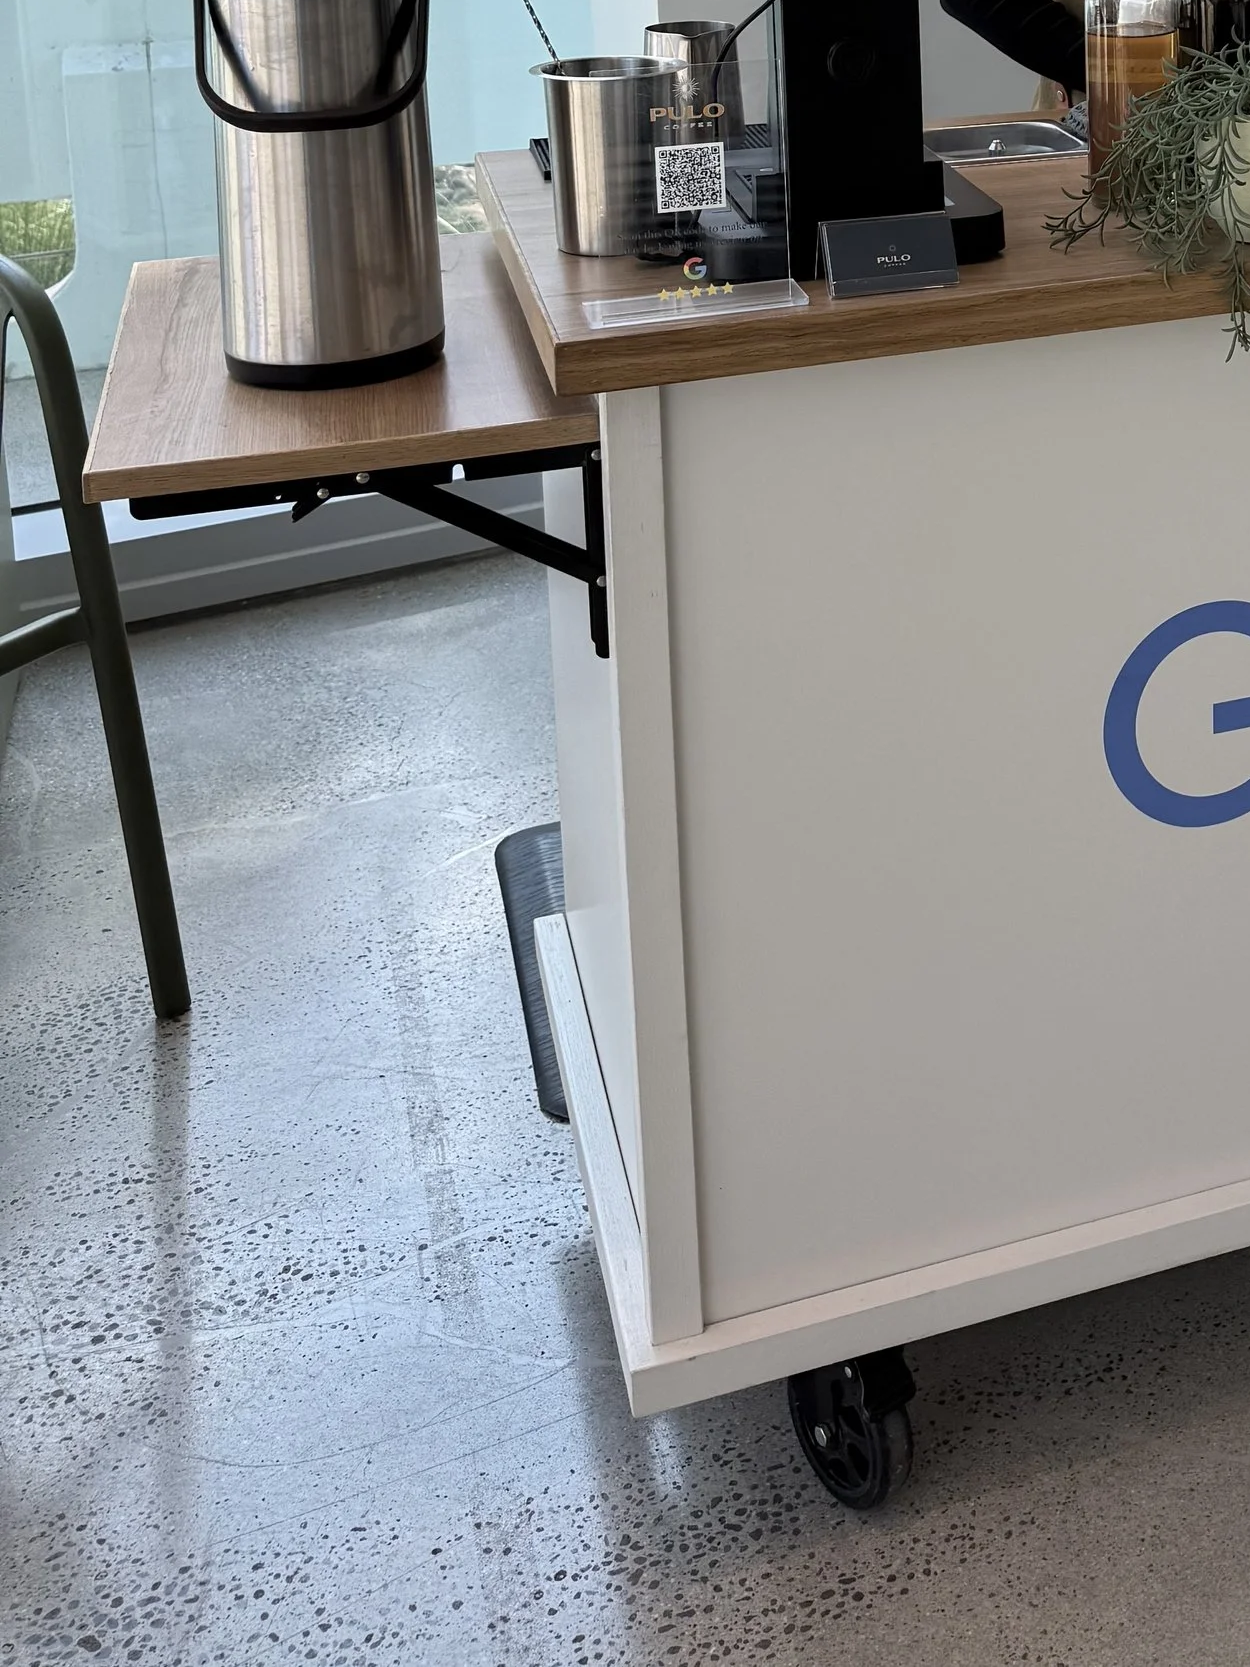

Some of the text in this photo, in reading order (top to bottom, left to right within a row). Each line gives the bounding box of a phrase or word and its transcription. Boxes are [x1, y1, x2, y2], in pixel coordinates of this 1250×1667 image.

[649, 102, 725, 122] PULO
[663, 121, 713, 130] COFFEE
[709, 224, 719, 232] to
[721, 222, 747, 232] make
[876, 254, 911, 264] PULO
[683, 256, 708, 280] G
